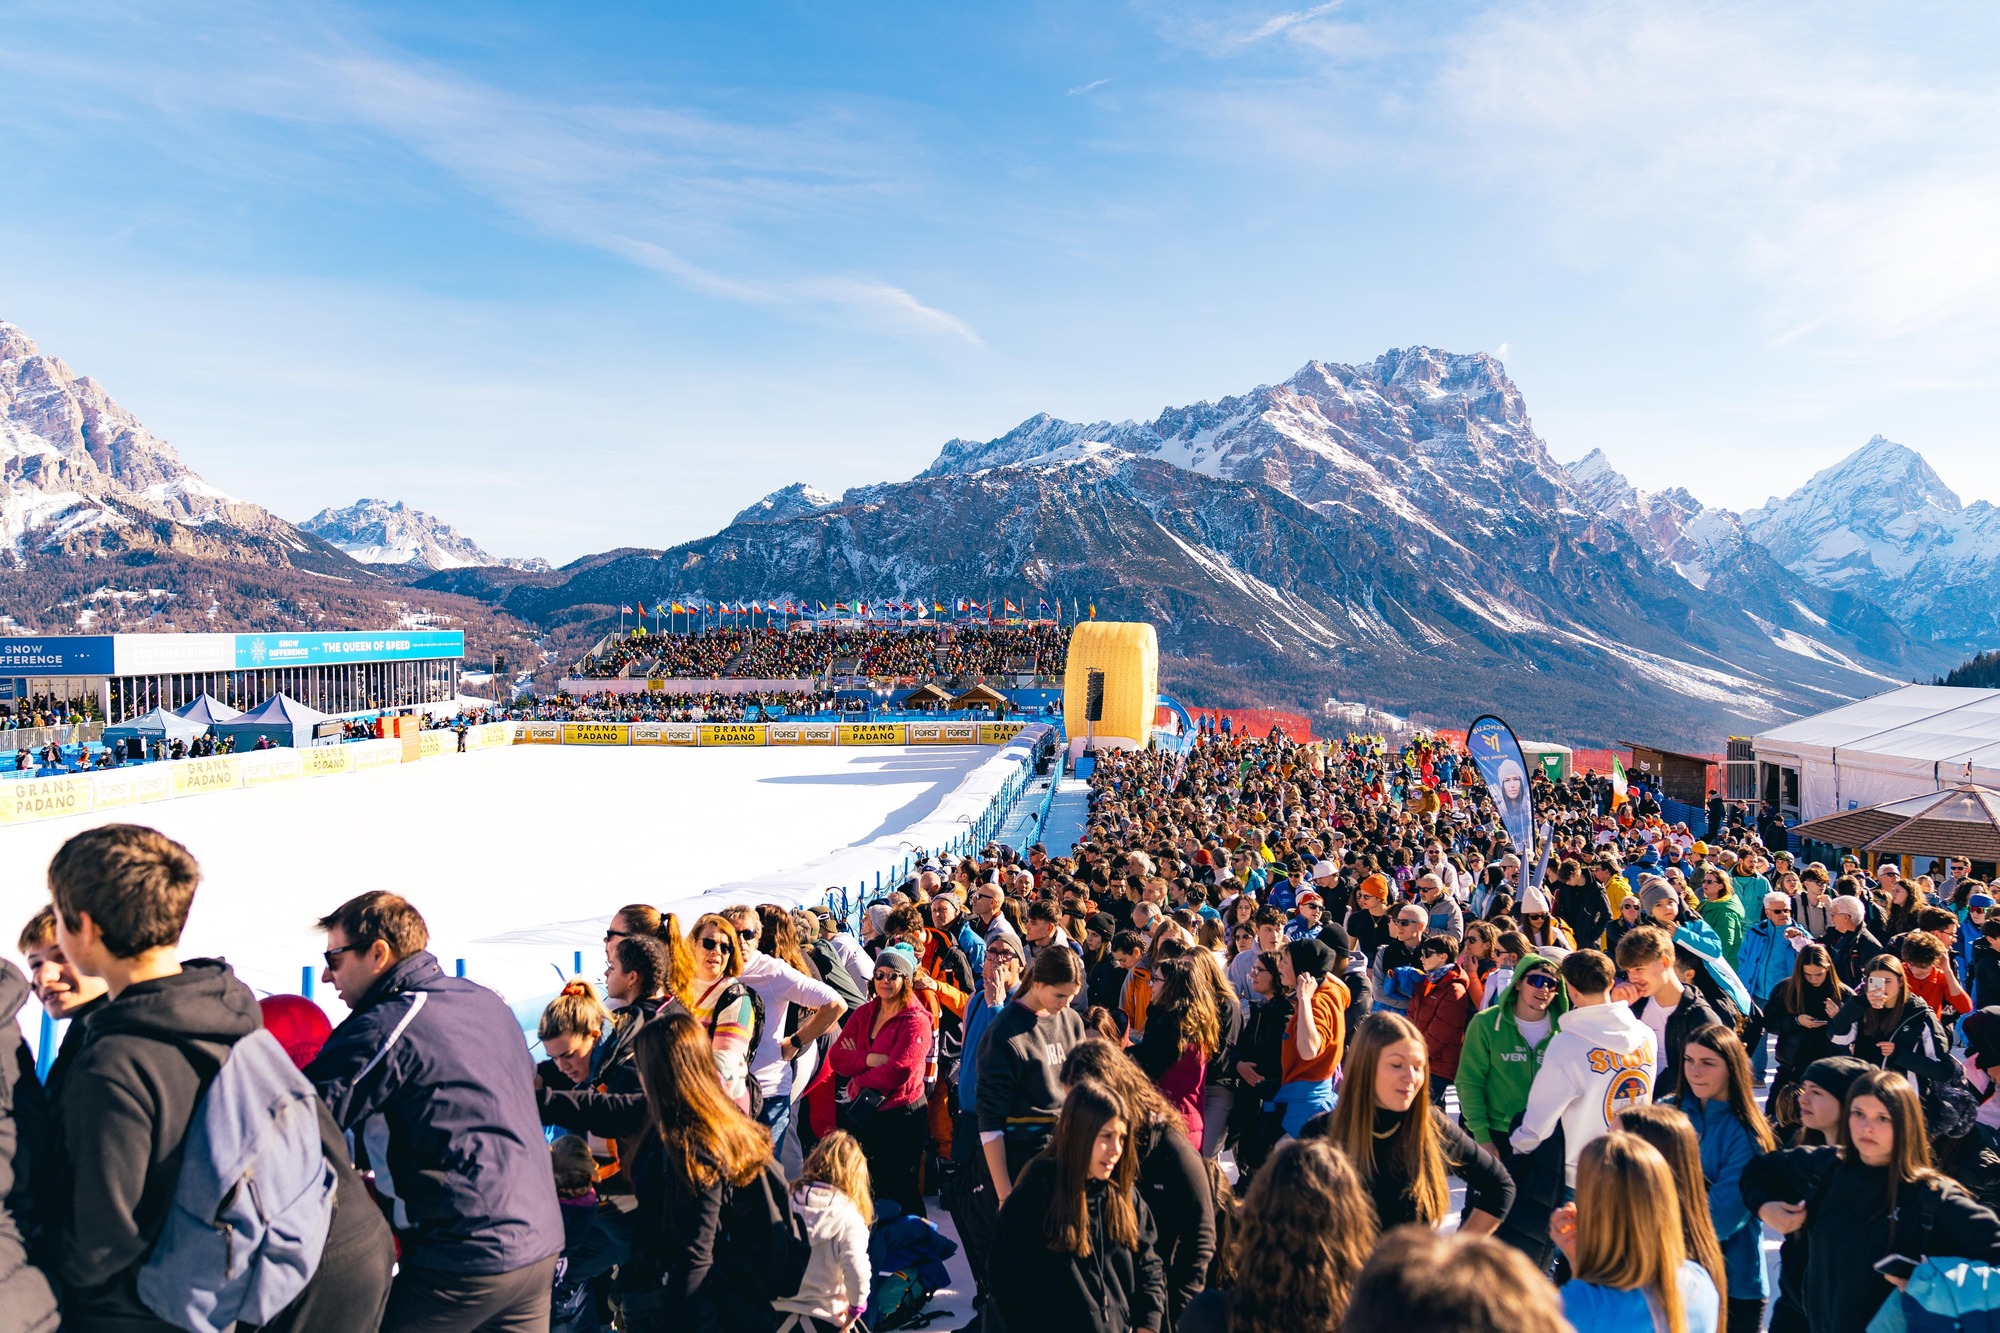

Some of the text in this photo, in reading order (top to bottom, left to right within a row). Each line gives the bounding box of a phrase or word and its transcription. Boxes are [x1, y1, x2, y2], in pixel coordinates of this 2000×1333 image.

[279, 640, 299, 648] SNOW
[323, 640, 410, 653] THE QUEEN OF SPEED
[5, 645, 43, 654] SNOW
[269, 648, 309, 657] DIFFERENCE
[577, 724, 617, 732] GRANA
[714, 725, 755, 733] GRANA
[994, 724, 1024, 732] GRA
[636, 731, 659, 739] FORST
[668, 731, 691, 739] FORST
[714, 733, 755, 741] PADANO
[853, 732, 895, 740] PADANO
[915, 729, 938, 737] FORST
[947, 729, 971, 737] FORST
[312, 747, 344, 759] GRANA
[187, 760, 229, 774] GRANA
[313, 758, 345, 769] PADANO
[187, 772, 231, 787] PADANO
[15, 780, 75, 798] GRANA
[16, 795, 75, 814] PADANO
